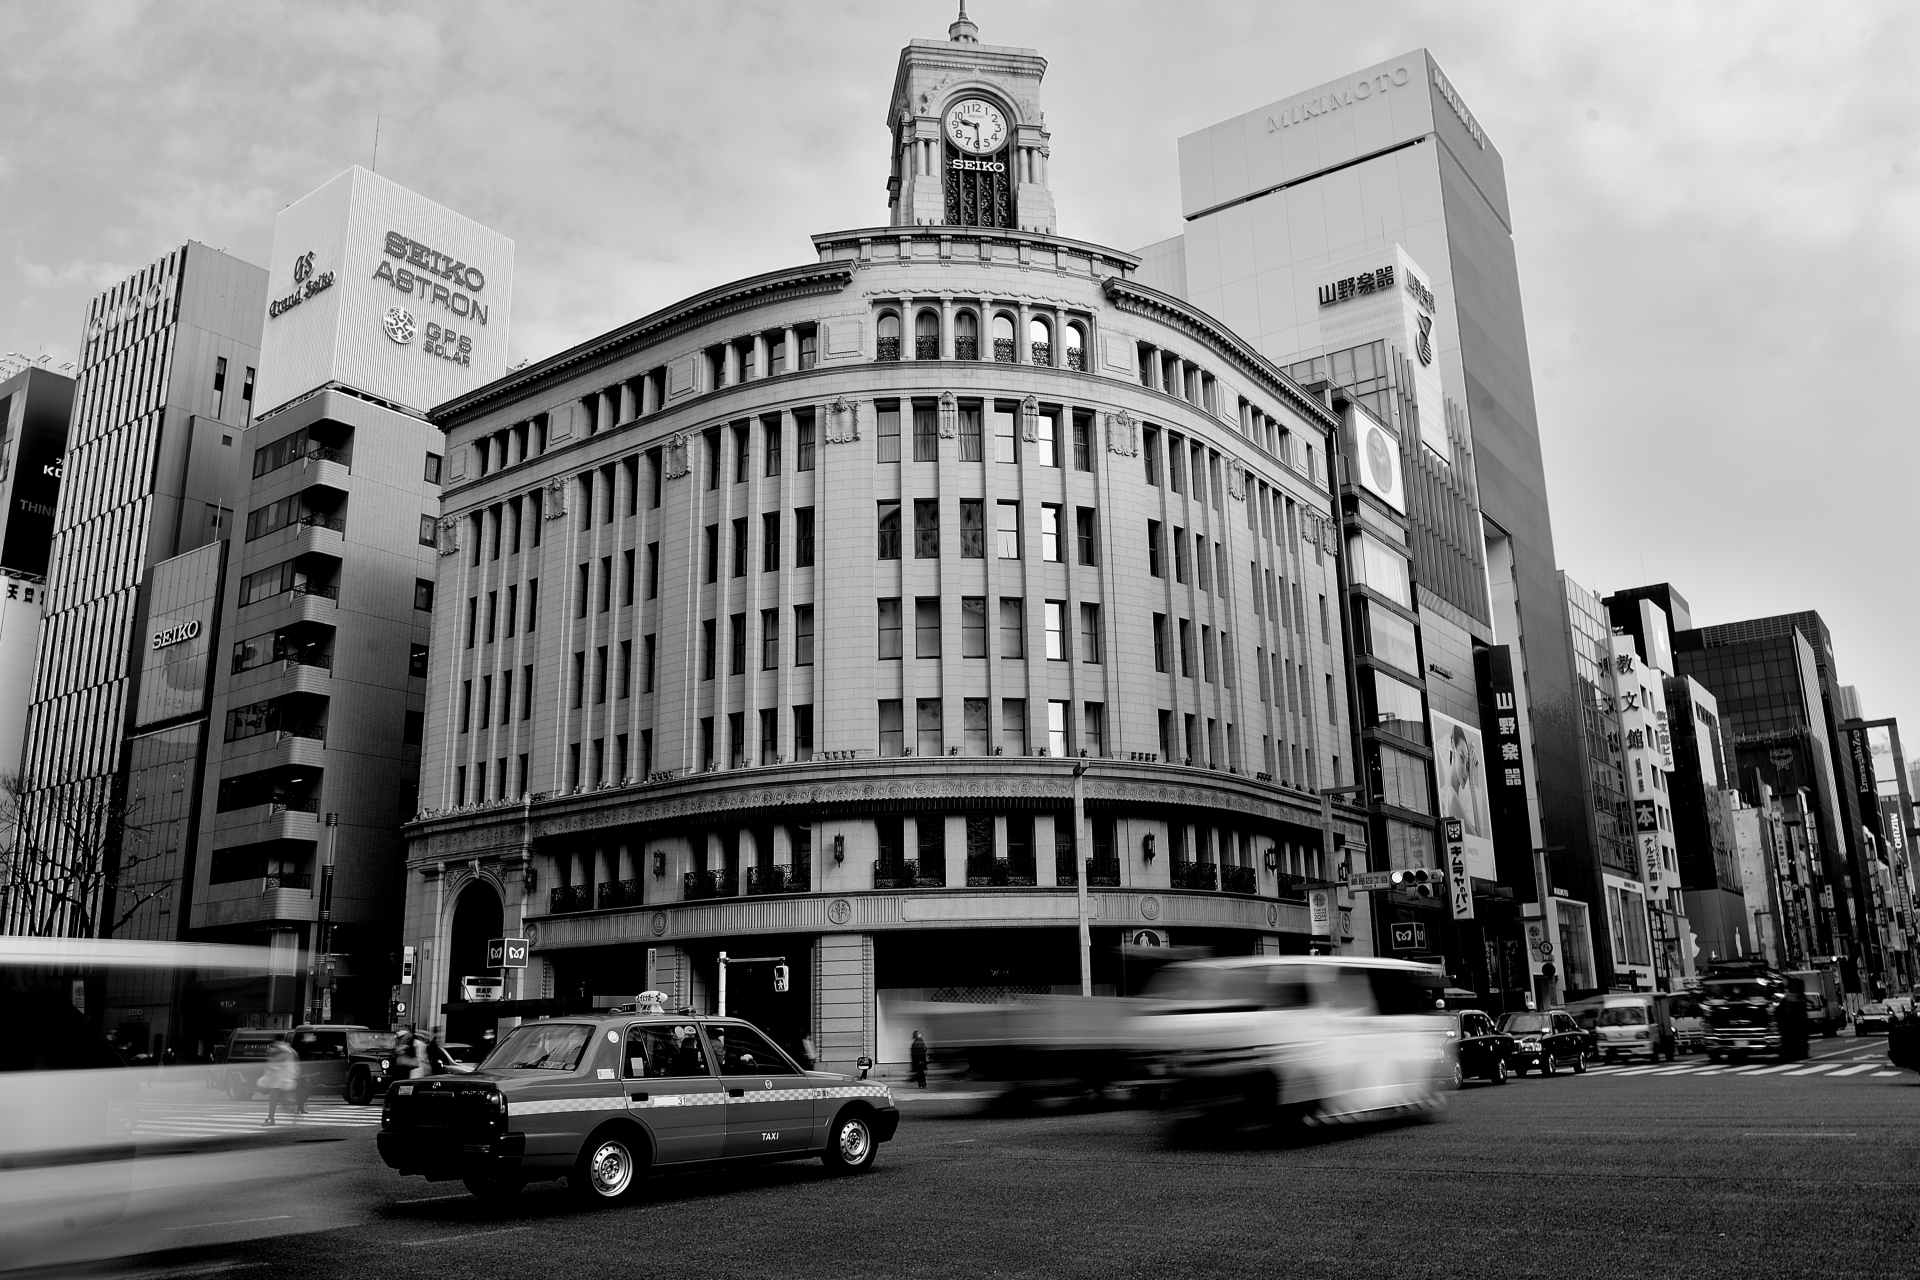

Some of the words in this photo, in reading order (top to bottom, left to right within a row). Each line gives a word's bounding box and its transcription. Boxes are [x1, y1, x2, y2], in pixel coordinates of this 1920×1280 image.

[972, 104, 981, 112] 12
[1268, 66, 1411, 133] MIKIMOTO
[1432, 68, 1485, 150] MIKIMOTO
[991, 114, 998, 123] 2
[952, 159, 1004, 172] SEIKO
[384, 231, 485, 291] SEIKO
[304, 269, 336, 299] Seiko
[372, 260, 488, 325] ASTRON
[1318, 265, 1395, 305] 山野楽器
[88, 274, 174, 343] GUCCI
[423, 340, 470, 367] SOLAR
[426, 322, 472, 353] GPS
[152, 620, 199, 650] SEIKO
[1616, 653, 1644, 750] 教文館
[1495, 692, 1521, 786] 山野楽器
[1636, 804, 1655, 827] 本
[1889, 812, 1902, 849] MIZUHO
[1350, 876, 1388, 886] 銀座四丁目
[1450, 846, 1468, 915] キムラヤのパン
[761, 1132, 779, 1141] TAXI
